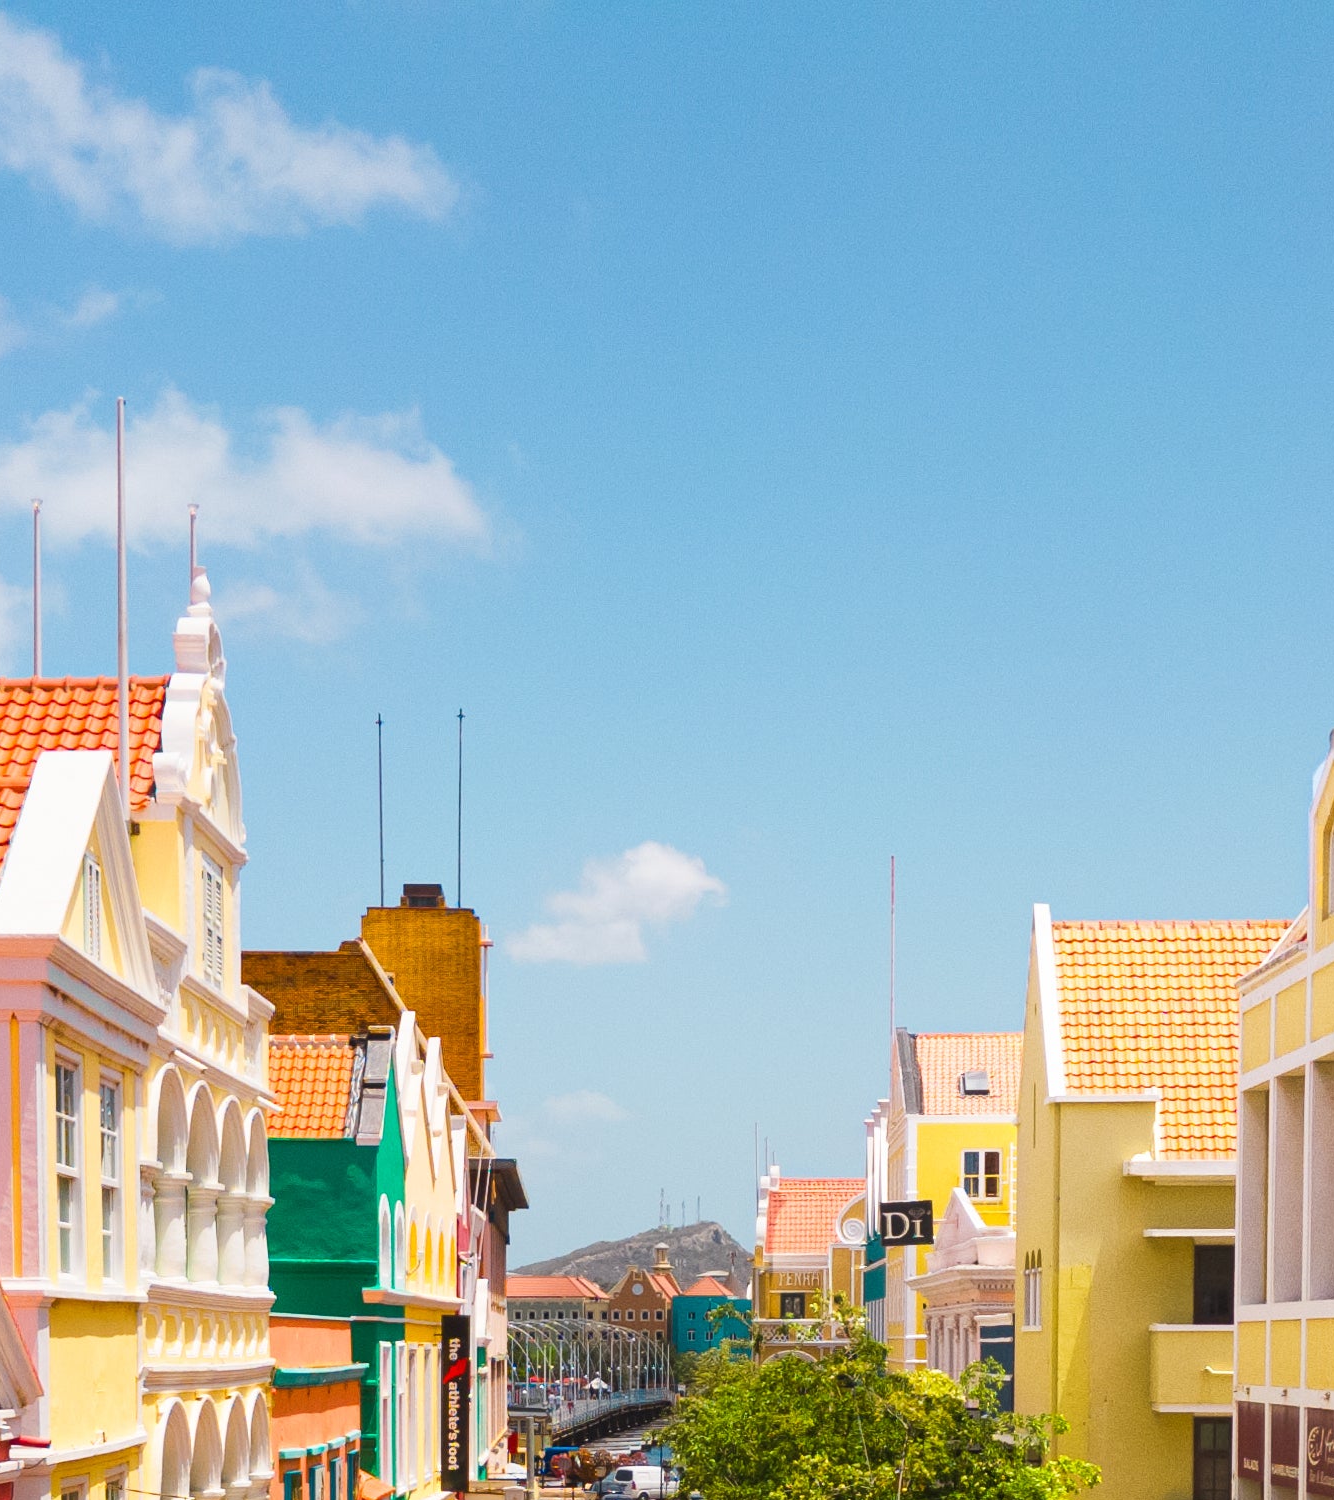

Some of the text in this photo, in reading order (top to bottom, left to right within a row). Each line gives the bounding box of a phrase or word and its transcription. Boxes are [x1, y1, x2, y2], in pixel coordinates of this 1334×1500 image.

[448, 1337, 462, 1471] the athlete's foot
